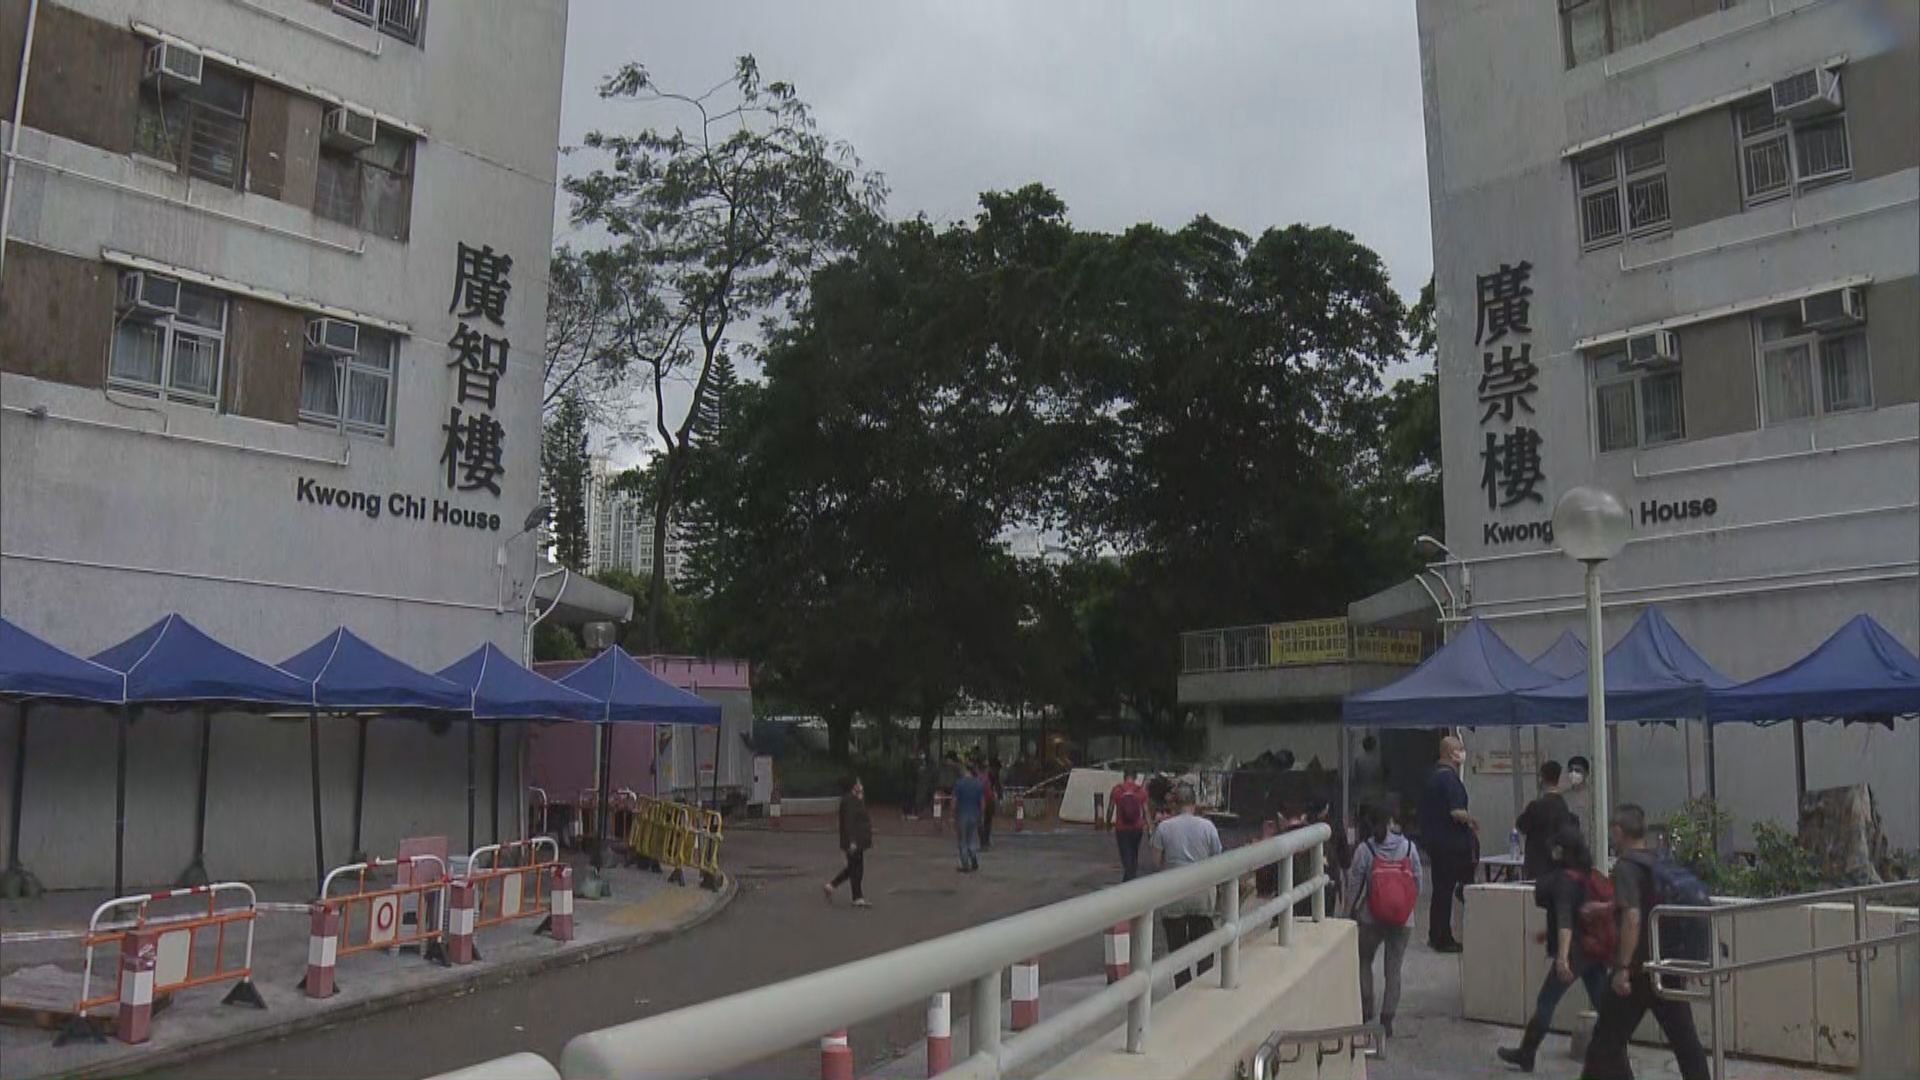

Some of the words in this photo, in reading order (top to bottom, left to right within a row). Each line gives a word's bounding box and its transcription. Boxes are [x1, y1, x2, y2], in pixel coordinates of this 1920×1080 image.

[440, 241, 513, 497] 廣智樓
[1475, 260, 1545, 511] 廣崇樓
[297, 477, 381, 516] Kwong
[389, 494, 425, 520] Chi
[433, 501, 501, 531] House
[1484, 520, 1553, 545] Kwong
[1640, 497, 1717, 525] House
